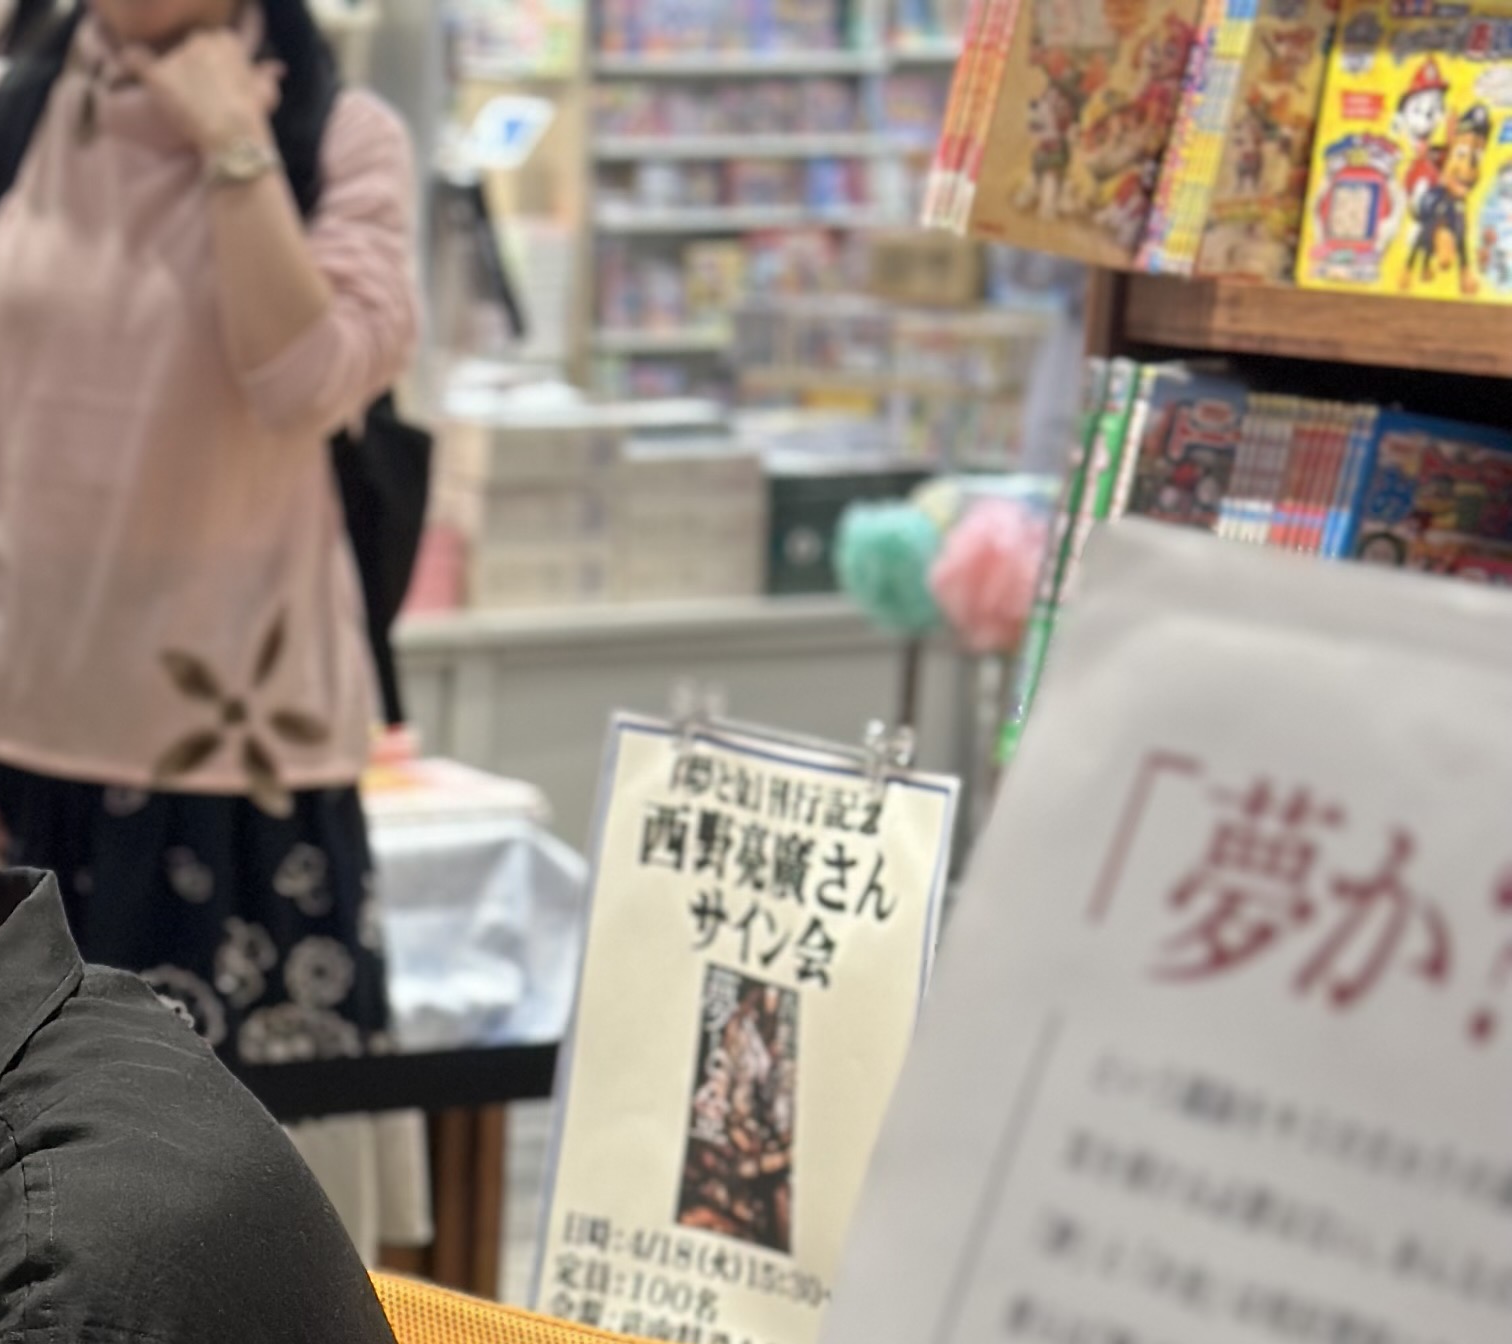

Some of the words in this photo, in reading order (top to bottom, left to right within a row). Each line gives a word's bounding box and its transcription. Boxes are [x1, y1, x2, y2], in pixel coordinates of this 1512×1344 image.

[640, 802, 898, 921] 西野亮廣さん
[688, 888, 837, 989] サイン会
